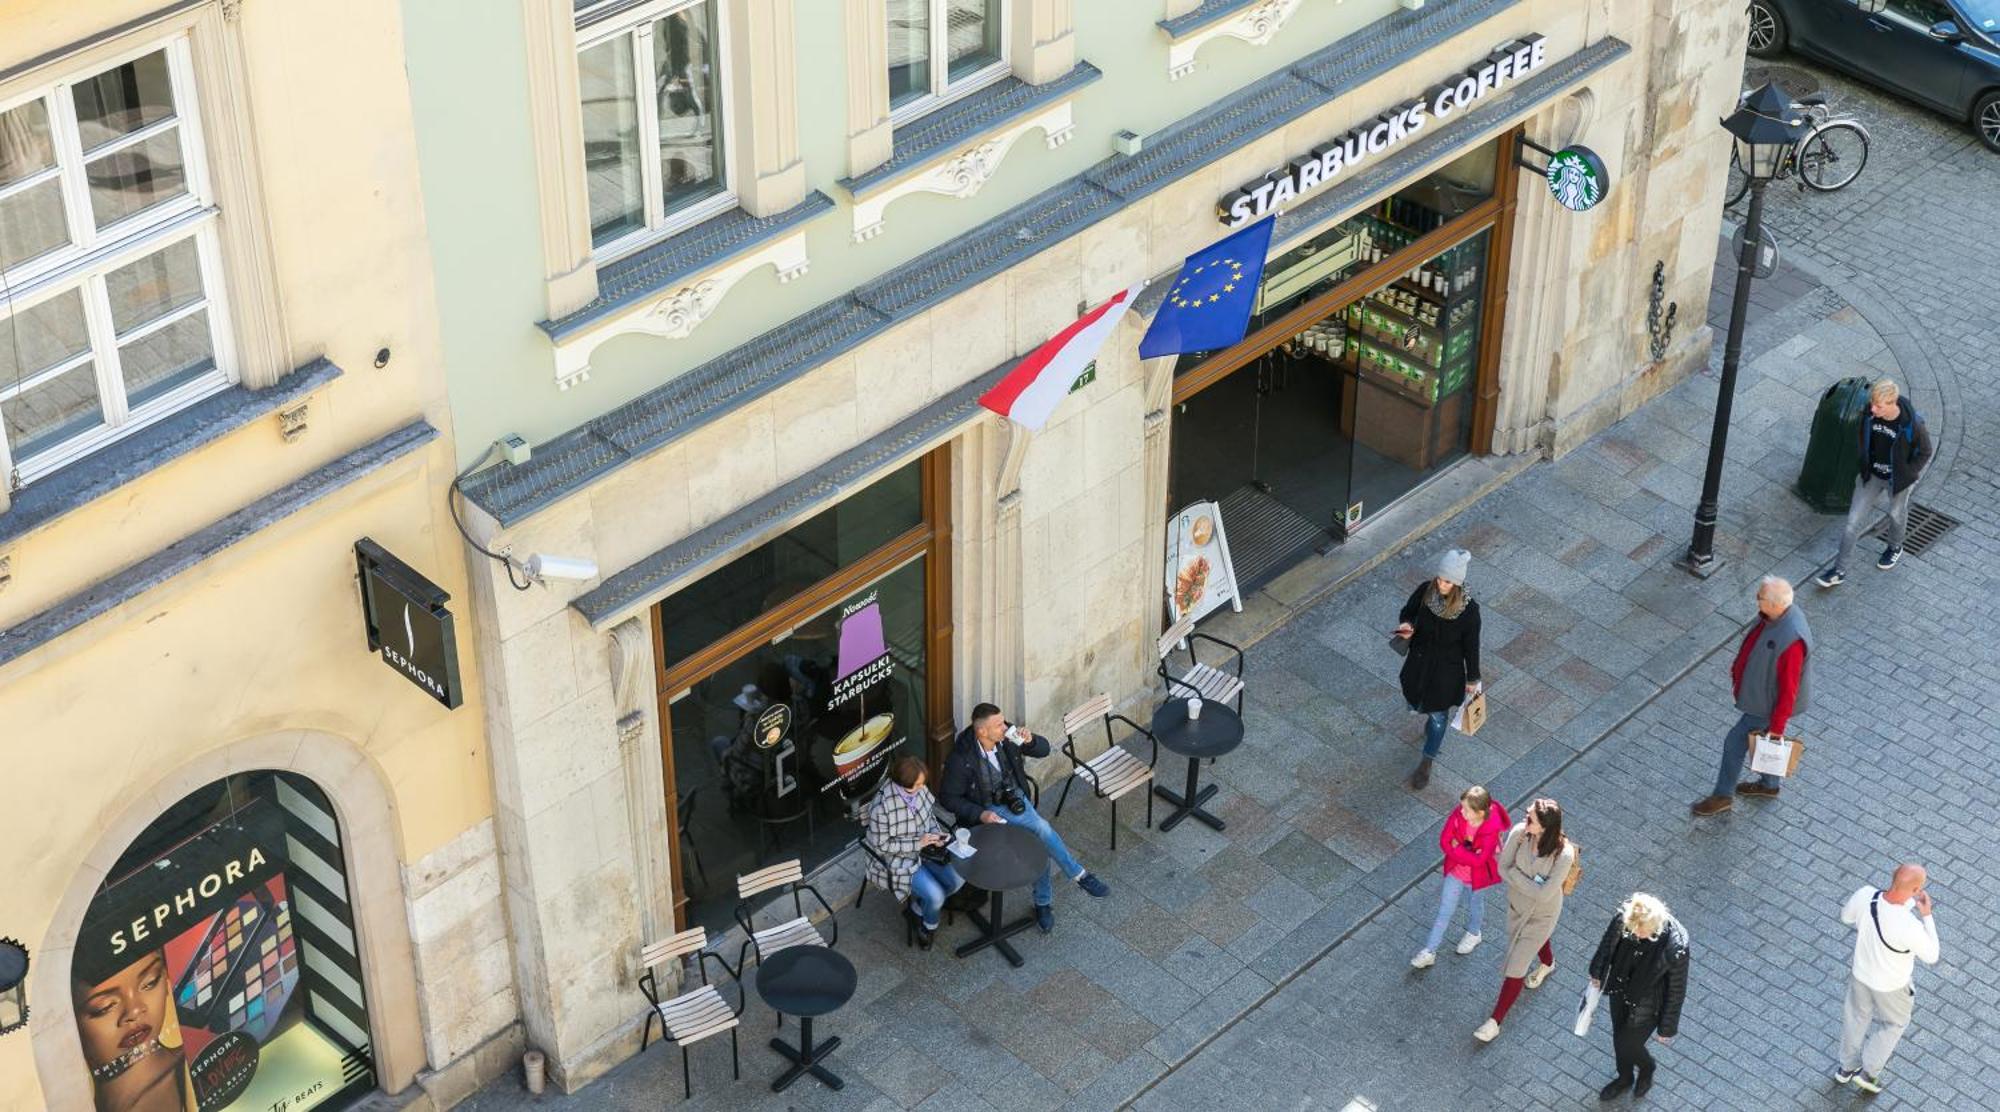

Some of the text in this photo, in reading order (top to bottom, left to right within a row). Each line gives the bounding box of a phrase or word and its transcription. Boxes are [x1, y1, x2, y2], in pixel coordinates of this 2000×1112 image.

[1229, 36, 1548, 228] STARBUCKS COFFEE
[384, 646, 446, 698] SEPHORA
[833, 655, 890, 696] KAPSUŁKI
[110, 847, 267, 955] SEPHORA
[191, 1036, 239, 1078] SEPHORA
[295, 1080, 323, 1104] BEATS
